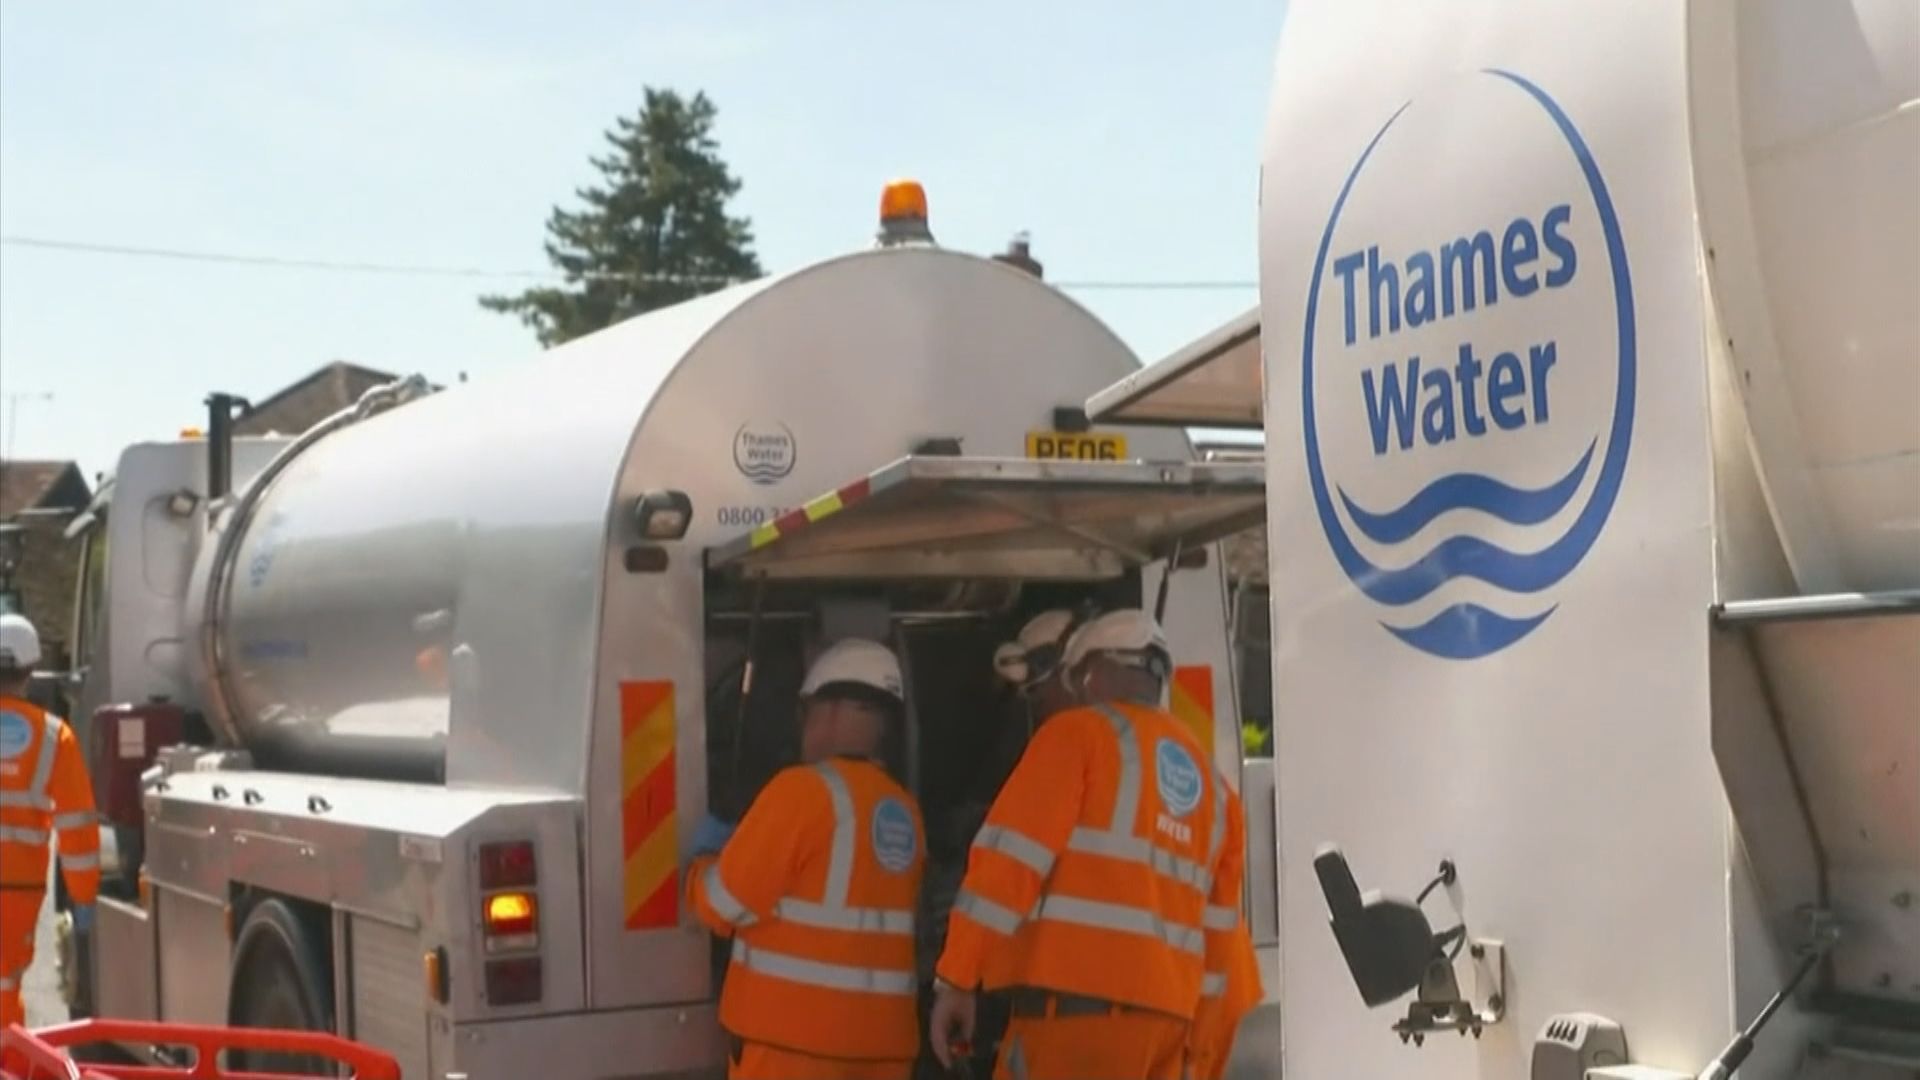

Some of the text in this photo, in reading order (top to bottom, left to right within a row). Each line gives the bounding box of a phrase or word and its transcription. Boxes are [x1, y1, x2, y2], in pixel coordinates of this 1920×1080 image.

[1333, 204, 1577, 346] Thames
[1361, 341, 1557, 456] Water
[717, 506, 765, 525] 0800
